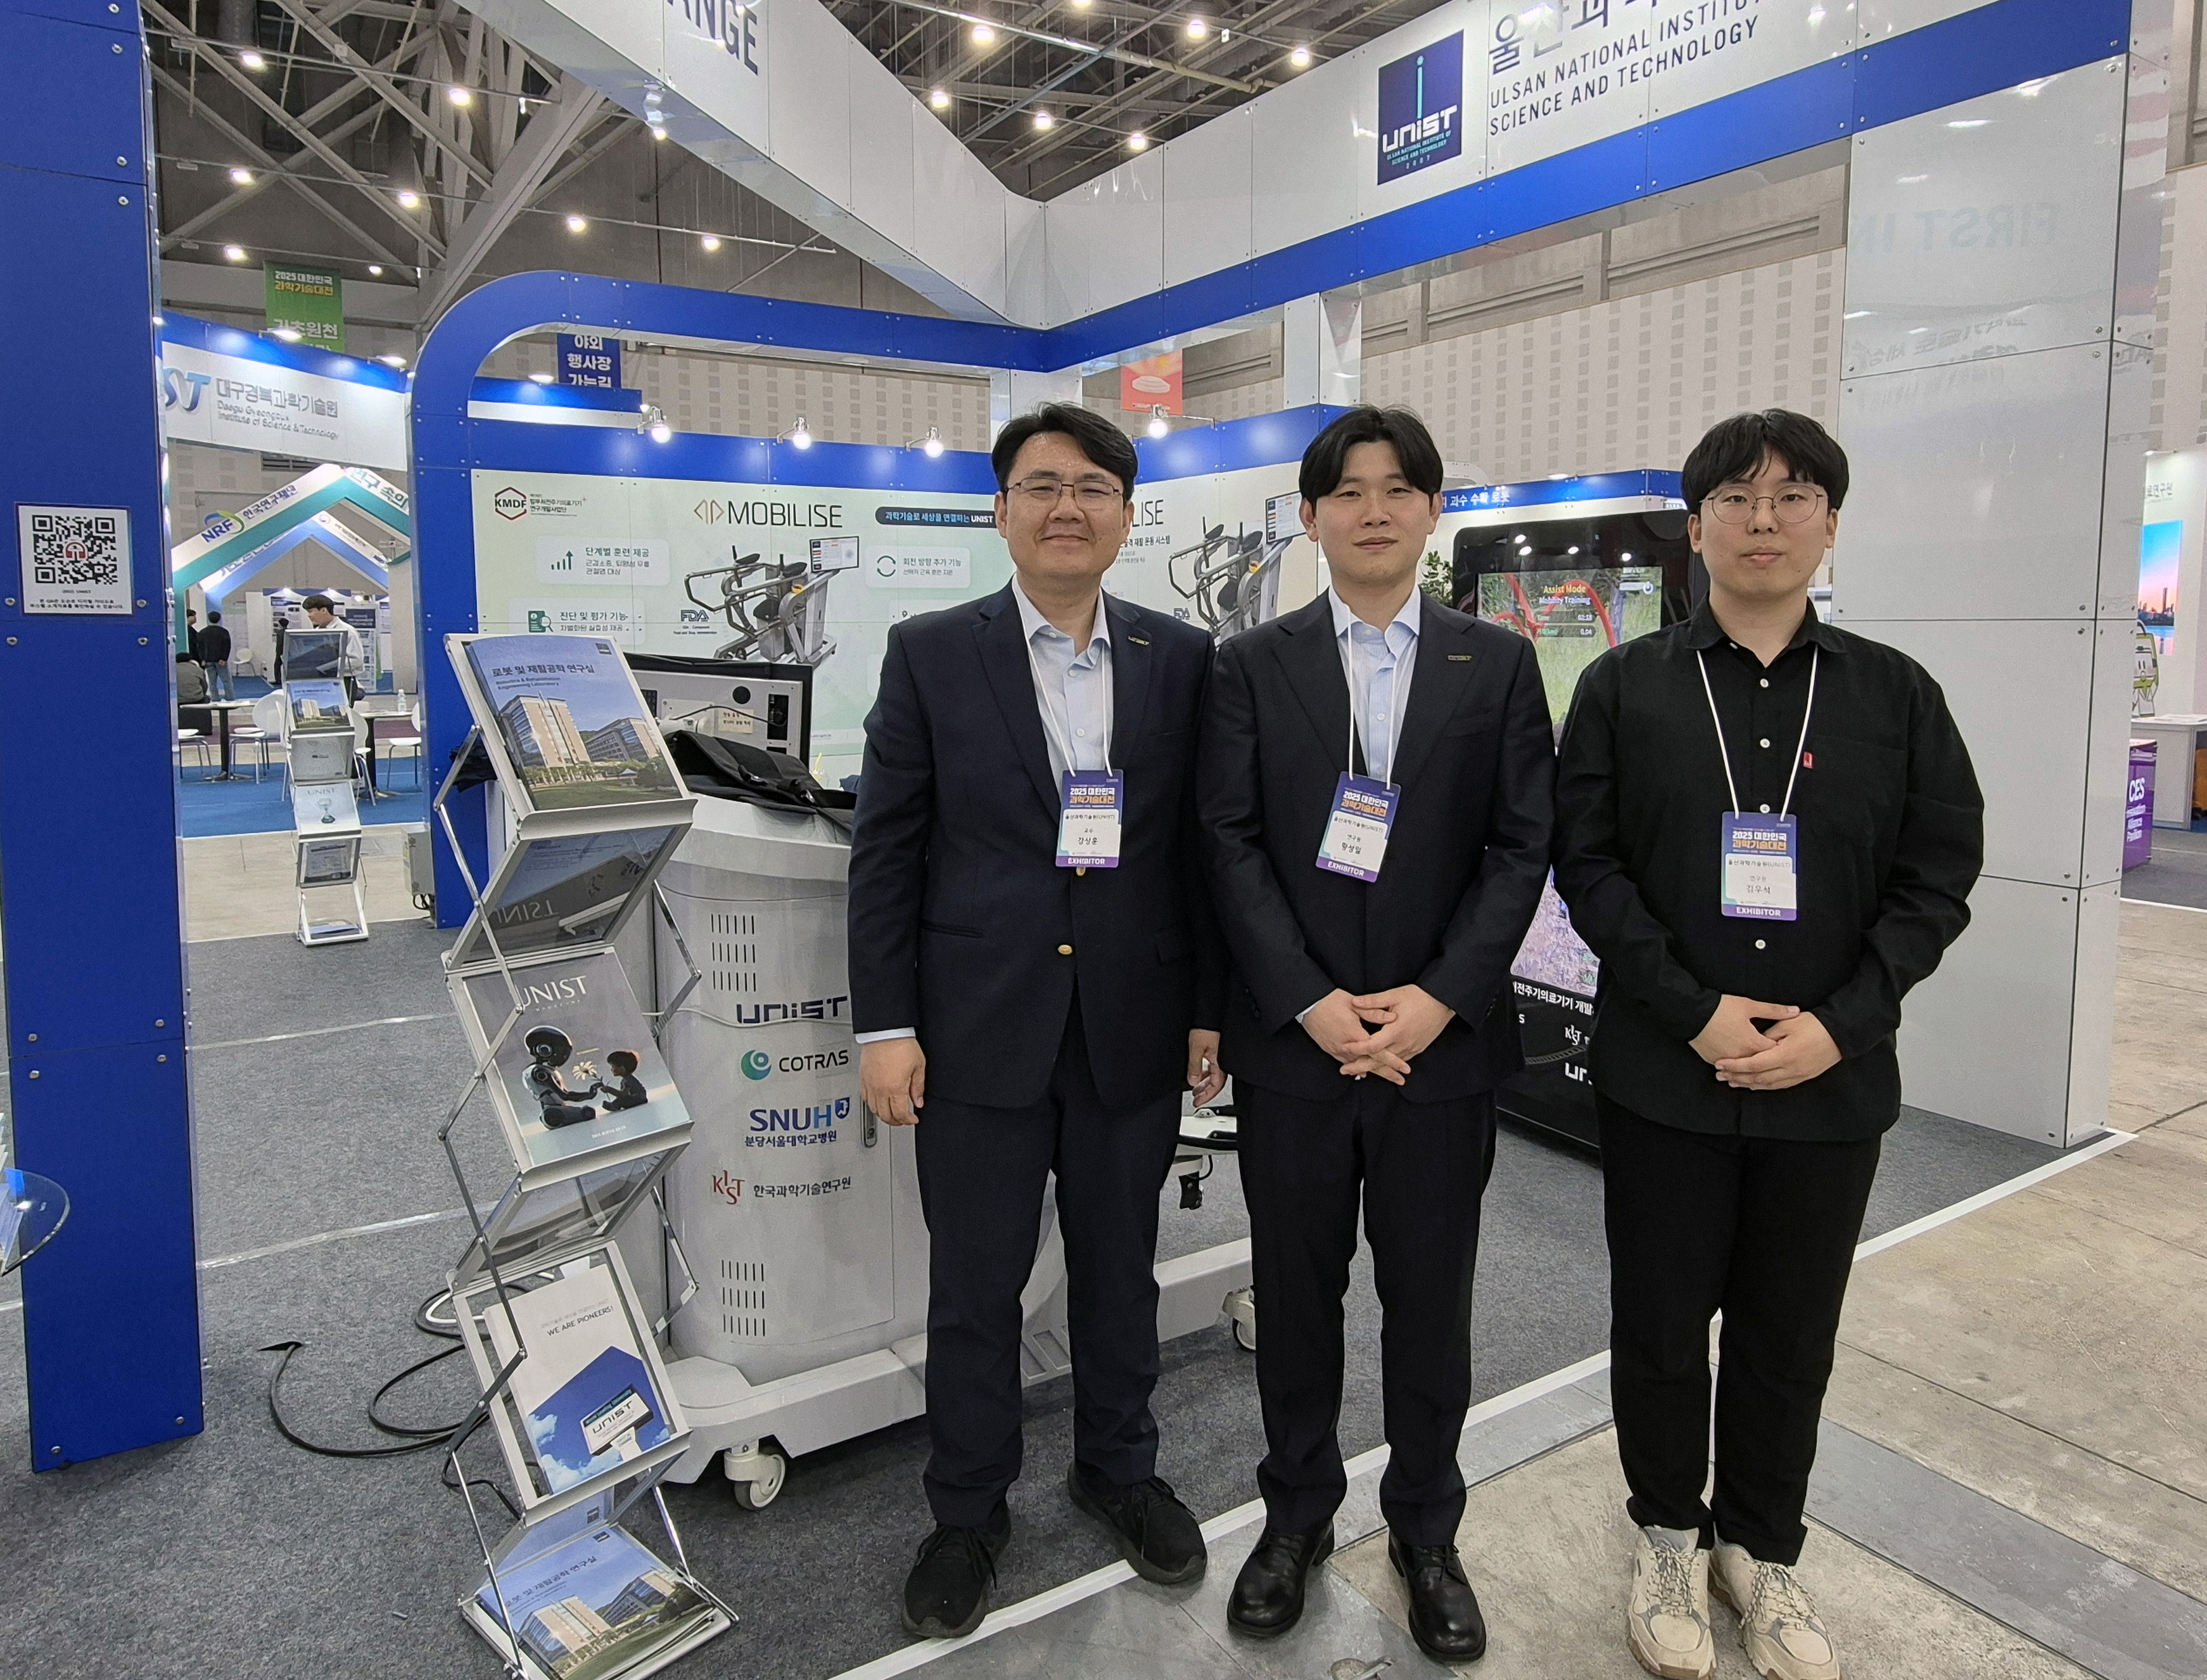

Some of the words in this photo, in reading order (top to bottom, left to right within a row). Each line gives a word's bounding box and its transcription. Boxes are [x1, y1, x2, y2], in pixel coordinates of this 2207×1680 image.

[1490, 92, 1563, 136] SCIENCE
[1571, 75, 1609, 106] AND
[1618, 15, 1759, 88] TECHNOLOGY
[1491, 70, 1546, 108] ULSAN
[1555, 29, 1650, 84] NATIONAL
[1387, 149, 1401, 160] ULSAN
[1401, 142, 1422, 154] NATIONAL
[1392, 152, 1408, 165] SCIENCE
[1409, 150, 1418, 159] AND
[1420, 139, 1447, 154] TECHNOLOGY
[275, 270, 296, 281] 2025
[297, 273, 333, 285] 대한민국
[275, 281, 333, 296] 과학기술대전
[575, 334, 602, 350] 야외
[567, 353, 611, 371] 행사장
[216, 378, 338, 417] 대구경북과학기술원
[217, 400, 243, 412] Daegu
[217, 412, 250, 424] Institute
[253, 417, 260, 426] of
[262, 419, 291, 432] Science
[243, 485, 298, 520] 한국연구재단
[495, 499, 527, 508] KMDF
[728, 500, 843, 528] MOBILISE
[885, 511, 920, 521] 과학기술로
[970, 514, 993, 523] UNIST
[201, 519, 232, 543] NRF
[585, 547, 611, 556] 단계별
[633, 549, 649, 557] 제공
[948, 558, 962, 566] 기능
[1544, 585, 1565, 594] Assist
[1566, 584, 1586, 593] Mode
[560, 611, 576, 621] 진단
[580, 611, 587, 621] 및
[590, 611, 607, 621] 평가
[610, 611, 626, 621] 기능
[680, 609, 709, 621] FDA
[492, 666, 512, 677] 로봇
[514, 665, 526, 675] 및
[528, 665, 566, 673] 재활공학
[567, 665, 595, 673] 연구실
[1070, 787, 1086, 796] 2025
[1343, 791, 1360, 801] 2025
[2129, 777, 2145, 803] CES
[1732, 839, 1787, 851] 과학기술대전
[1733, 831, 1753, 840] 2025
[1753, 832, 1786, 841] 대한민국
[1328, 861, 1364, 877] EXHIBITOR
[1736, 907, 1781, 917] EXHIBITOR
[515, 976, 587, 1007] UNIST
[736, 995, 848, 1024] UNIST
[779, 1050, 849, 1073] COTRAS
[749, 1104, 832, 1132] SNUH
[744, 1130, 837, 1148] 분당서울대학교병원
[712, 1169, 745, 1205] KIST
[753, 1176, 851, 1198] 한국과학기술연구원
[547, 1327, 561, 1336] WE
[562, 1320, 576, 1331] ARE
[577, 1305, 614, 1324] PIONEERS!
[592, 1401, 632, 1434] UNIST
